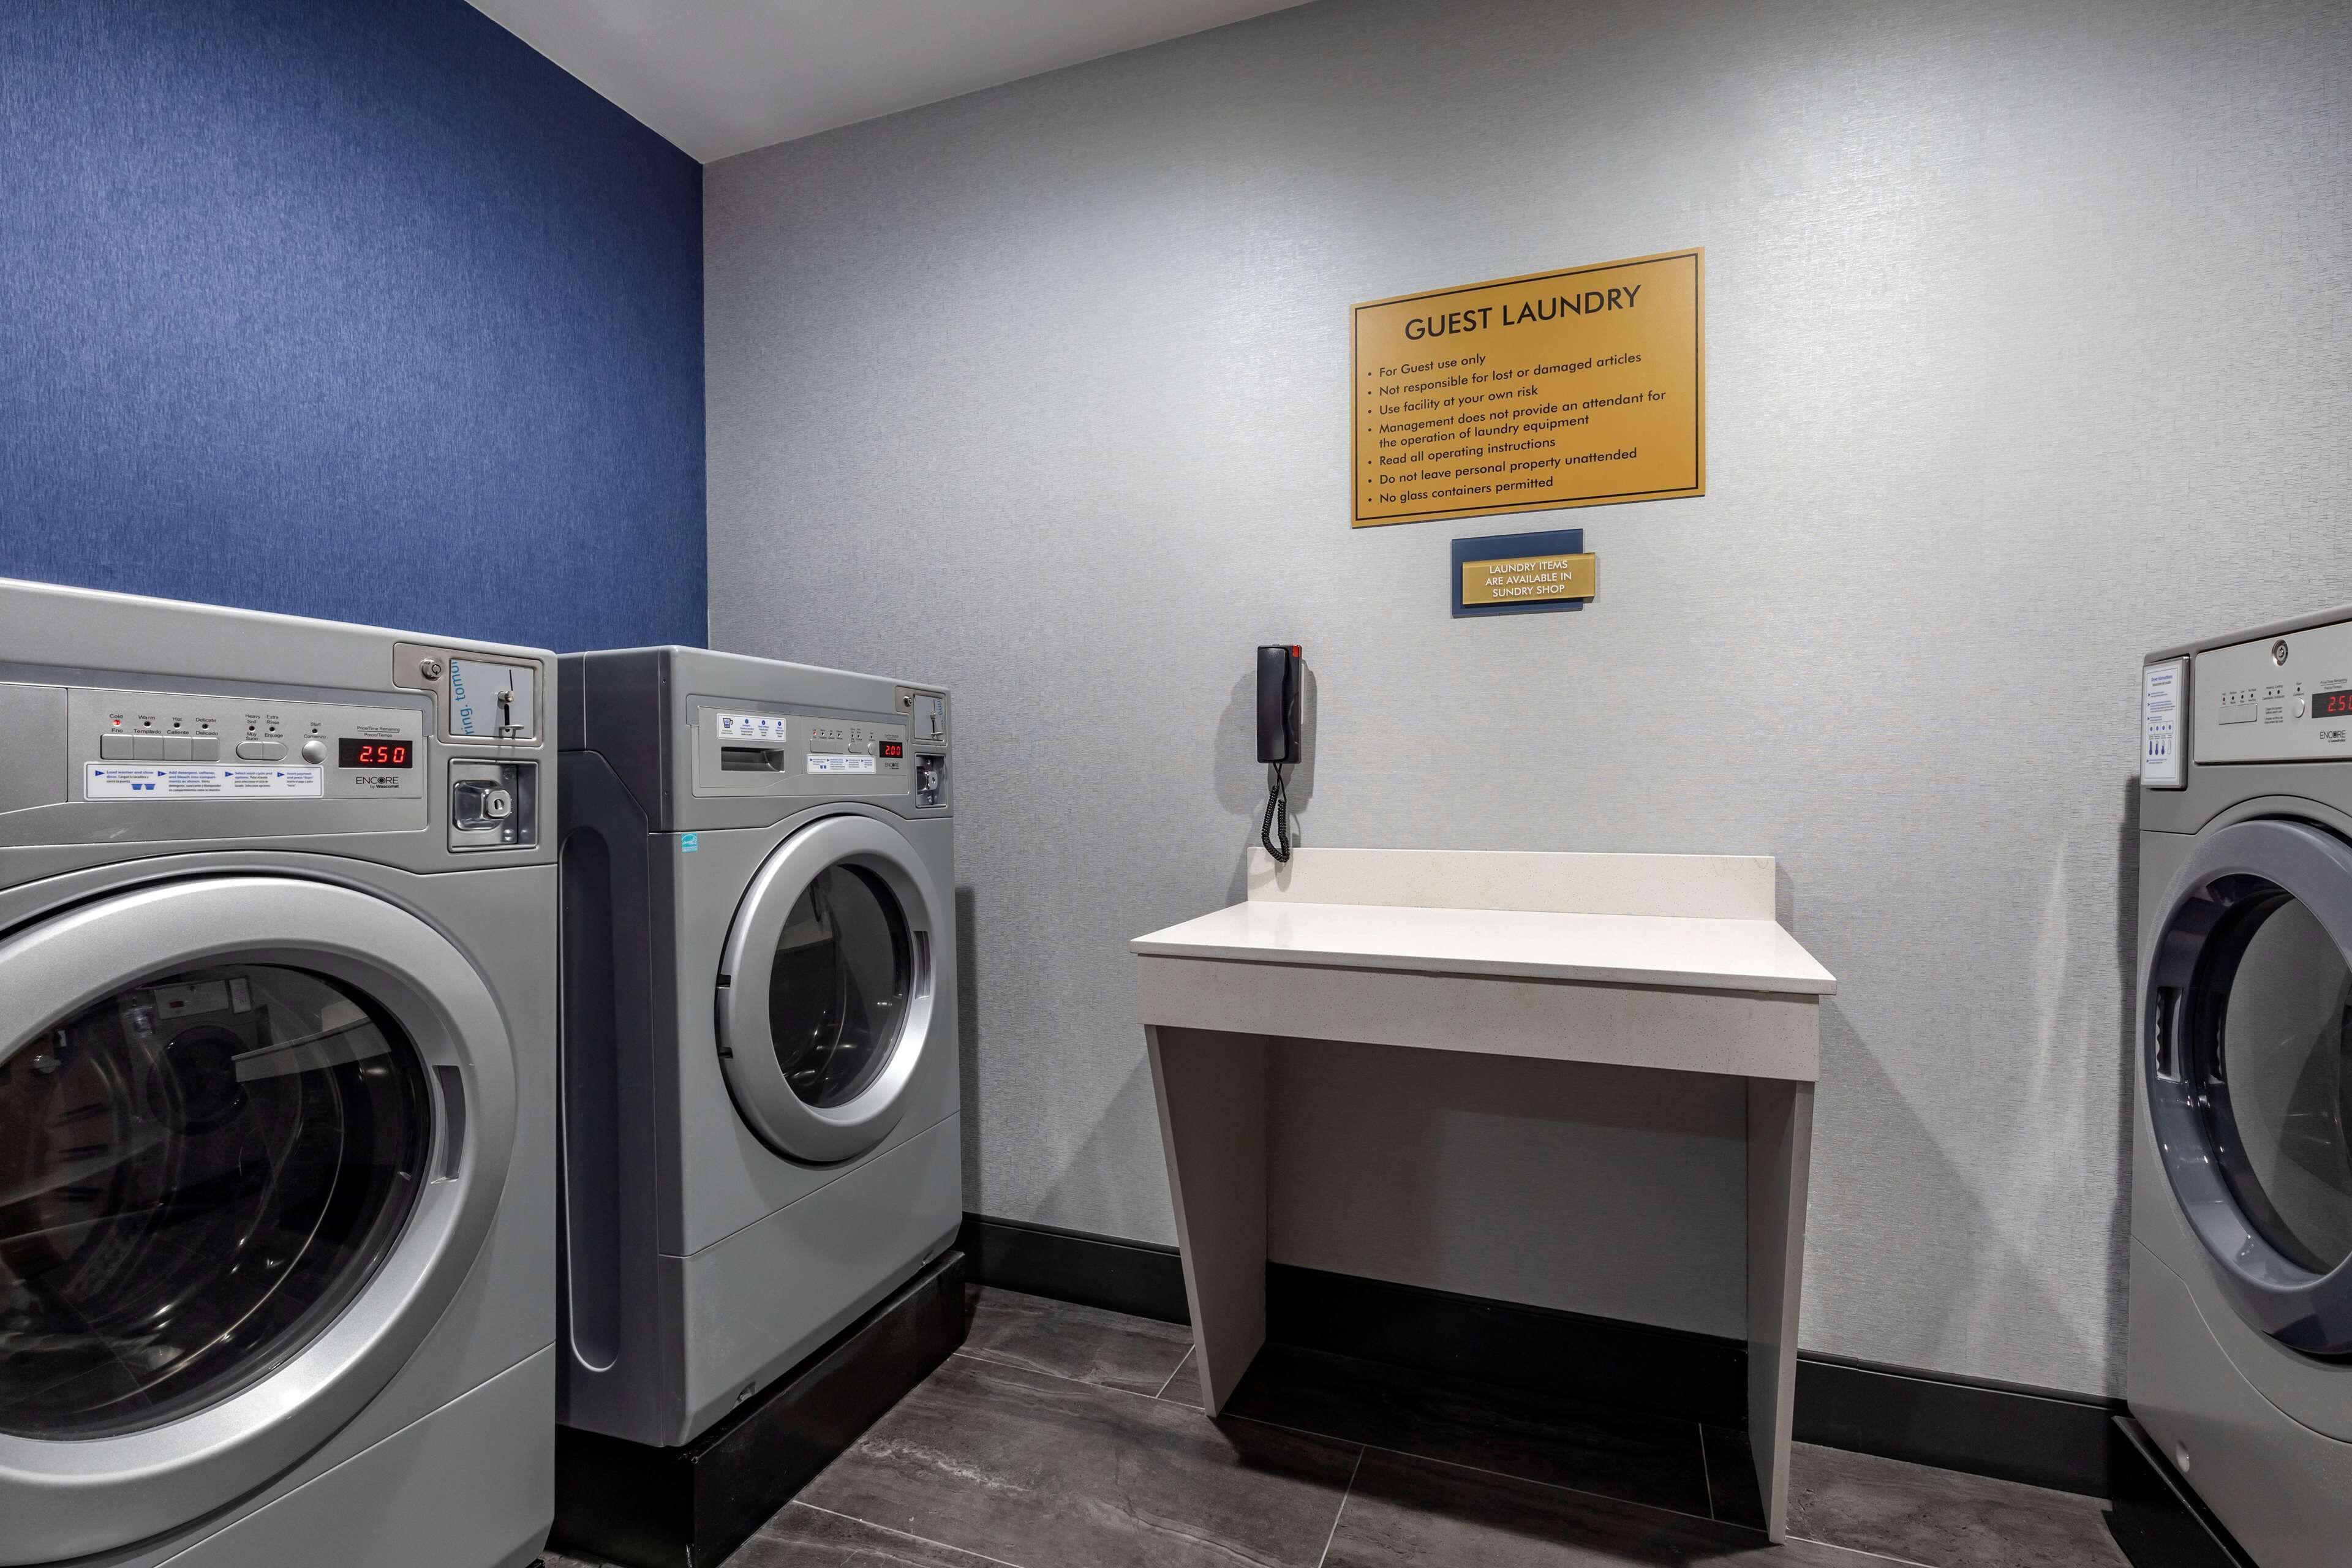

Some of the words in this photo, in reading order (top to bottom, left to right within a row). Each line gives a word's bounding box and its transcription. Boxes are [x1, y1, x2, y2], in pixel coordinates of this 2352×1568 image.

[1405, 307, 1493, 340] GUEST
[1503, 285, 1642, 326] LAUNDRY
[1380, 368, 1397, 377] For
[1401, 361, 1434, 374] Guest
[1438, 360, 1457, 369] use
[1461, 353, 1486, 366] only
[1380, 385, 1400, 396] Not
[1404, 375, 1468, 393] responsible
[1472, 373, 1488, 383] for
[1493, 369, 1513, 381] lost
[1517, 369, 1530, 377] or
[1534, 358, 1592, 375] damaged
[1597, 353, 1642, 367] articles
[1379, 416, 1454, 434] Management
[1458, 413, 1485, 424] does
[1490, 409, 1509, 420] not
[1513, 402, 1558, 420] provide
[1562, 403, 1577, 412] an
[1582, 393, 1643, 409] attendant
[1648, 390, 1666, 401] for
[1380, 405, 1400, 415] Use
[1403, 399, 1440, 412] facility
[1444, 397, 1455, 406] at
[1458, 394, 1485, 407] your
[1488, 391, 1513, 401] own
[1518, 385, 1538, 397] risk
[1379, 438, 1396, 448] the
[1401, 431, 1455, 447] operation
[1459, 427, 1471, 439] of
[1475, 423, 1520, 437] laundry
[1523, 415, 1589, 433] equipment
[1380, 453, 1406, 466] Read
[1411, 451, 1423, 462] all
[1428, 446, 1483, 462] operating
[1488, 439, 1556, 453] instructions
[1380, 475, 1395, 484] Do
[1400, 472, 1417, 482] not
[1422, 470, 1451, 480] leave
[1455, 461, 1506, 479] personal
[1510, 457, 1561, 473] property
[1565, 447, 1637, 465] unattended
[1380, 493, 1396, 503] No
[1400, 490, 1428, 503] glass
[1431, 485, 1491, 498] containers
[1496, 476, 1553, 494] permitted
[1485, 576, 1503, 586] ARE
[1506, 573, 1557, 584] AVAILABLE
[1561, 572, 1572, 581] IN
[1490, 562, 1536, 574] LAUNDRY
[1539, 560, 1568, 570] ITEMS
[1493, 586, 1534, 597] SUNDRY
[1537, 584, 1565, 594] SHOP
[2320, 730, 2346, 739] ENCORE
[360, 746, 405, 763] 2.50
[886, 745, 900, 755] 2.00
[356, 776, 399, 785] ENCORE
